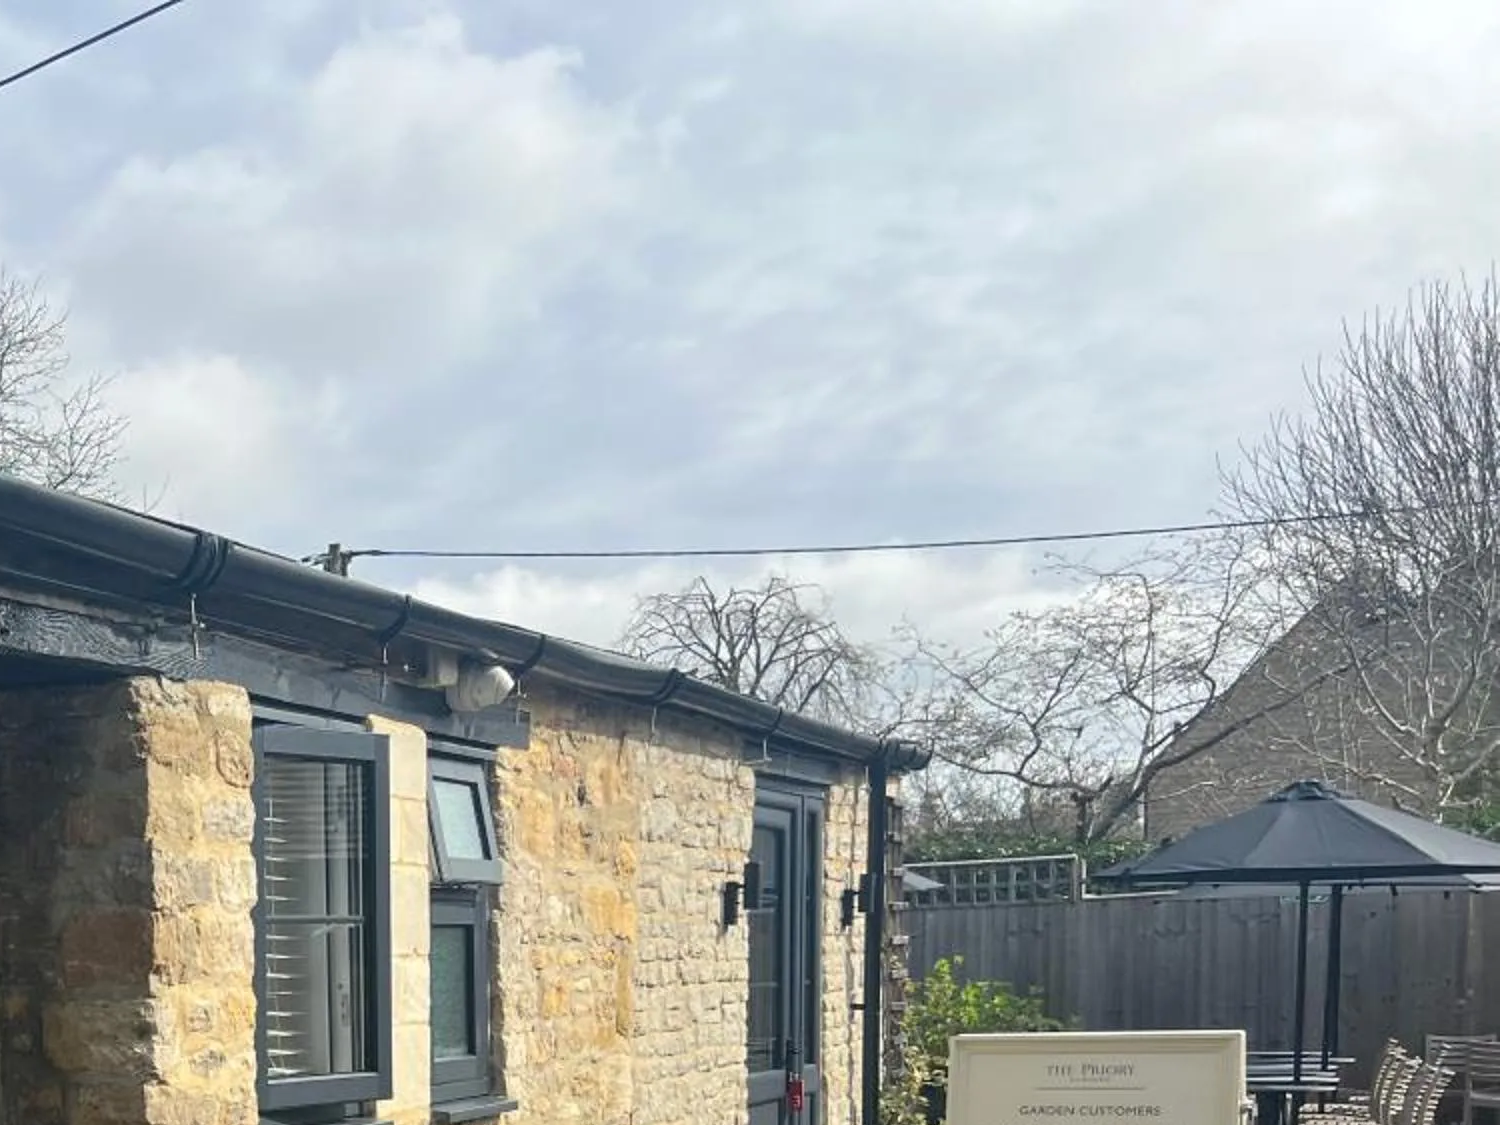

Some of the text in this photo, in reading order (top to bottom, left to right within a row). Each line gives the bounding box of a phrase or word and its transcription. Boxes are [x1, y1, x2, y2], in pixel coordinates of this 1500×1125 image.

[1046, 1064, 1072, 1077] THE
[1019, 1104, 1161, 1117] GARDEN CUSTOMERS
